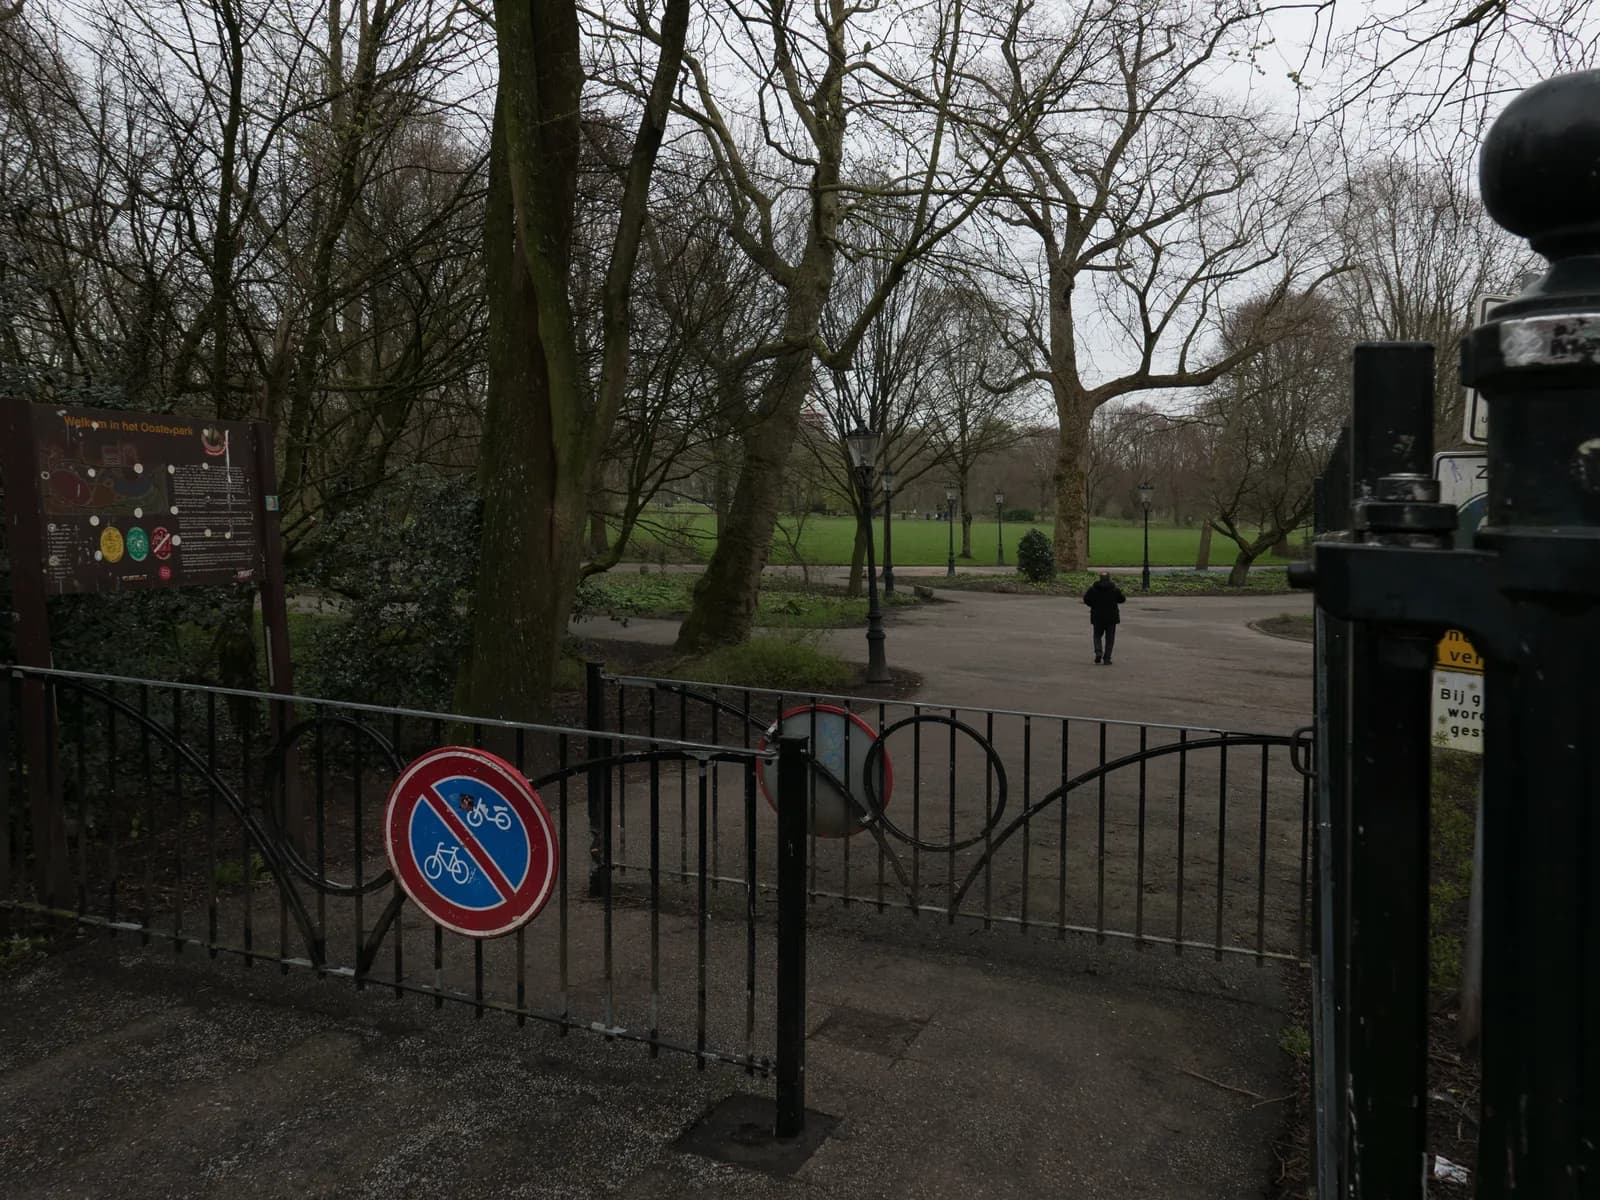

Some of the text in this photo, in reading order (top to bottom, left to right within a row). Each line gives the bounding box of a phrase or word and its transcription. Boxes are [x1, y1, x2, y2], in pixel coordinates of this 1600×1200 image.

[64, 416, 106, 429] Welkm
[110, 420, 120, 429] in
[123, 420, 138, 431] het
[1441, 688, 1464, 705] Bij
